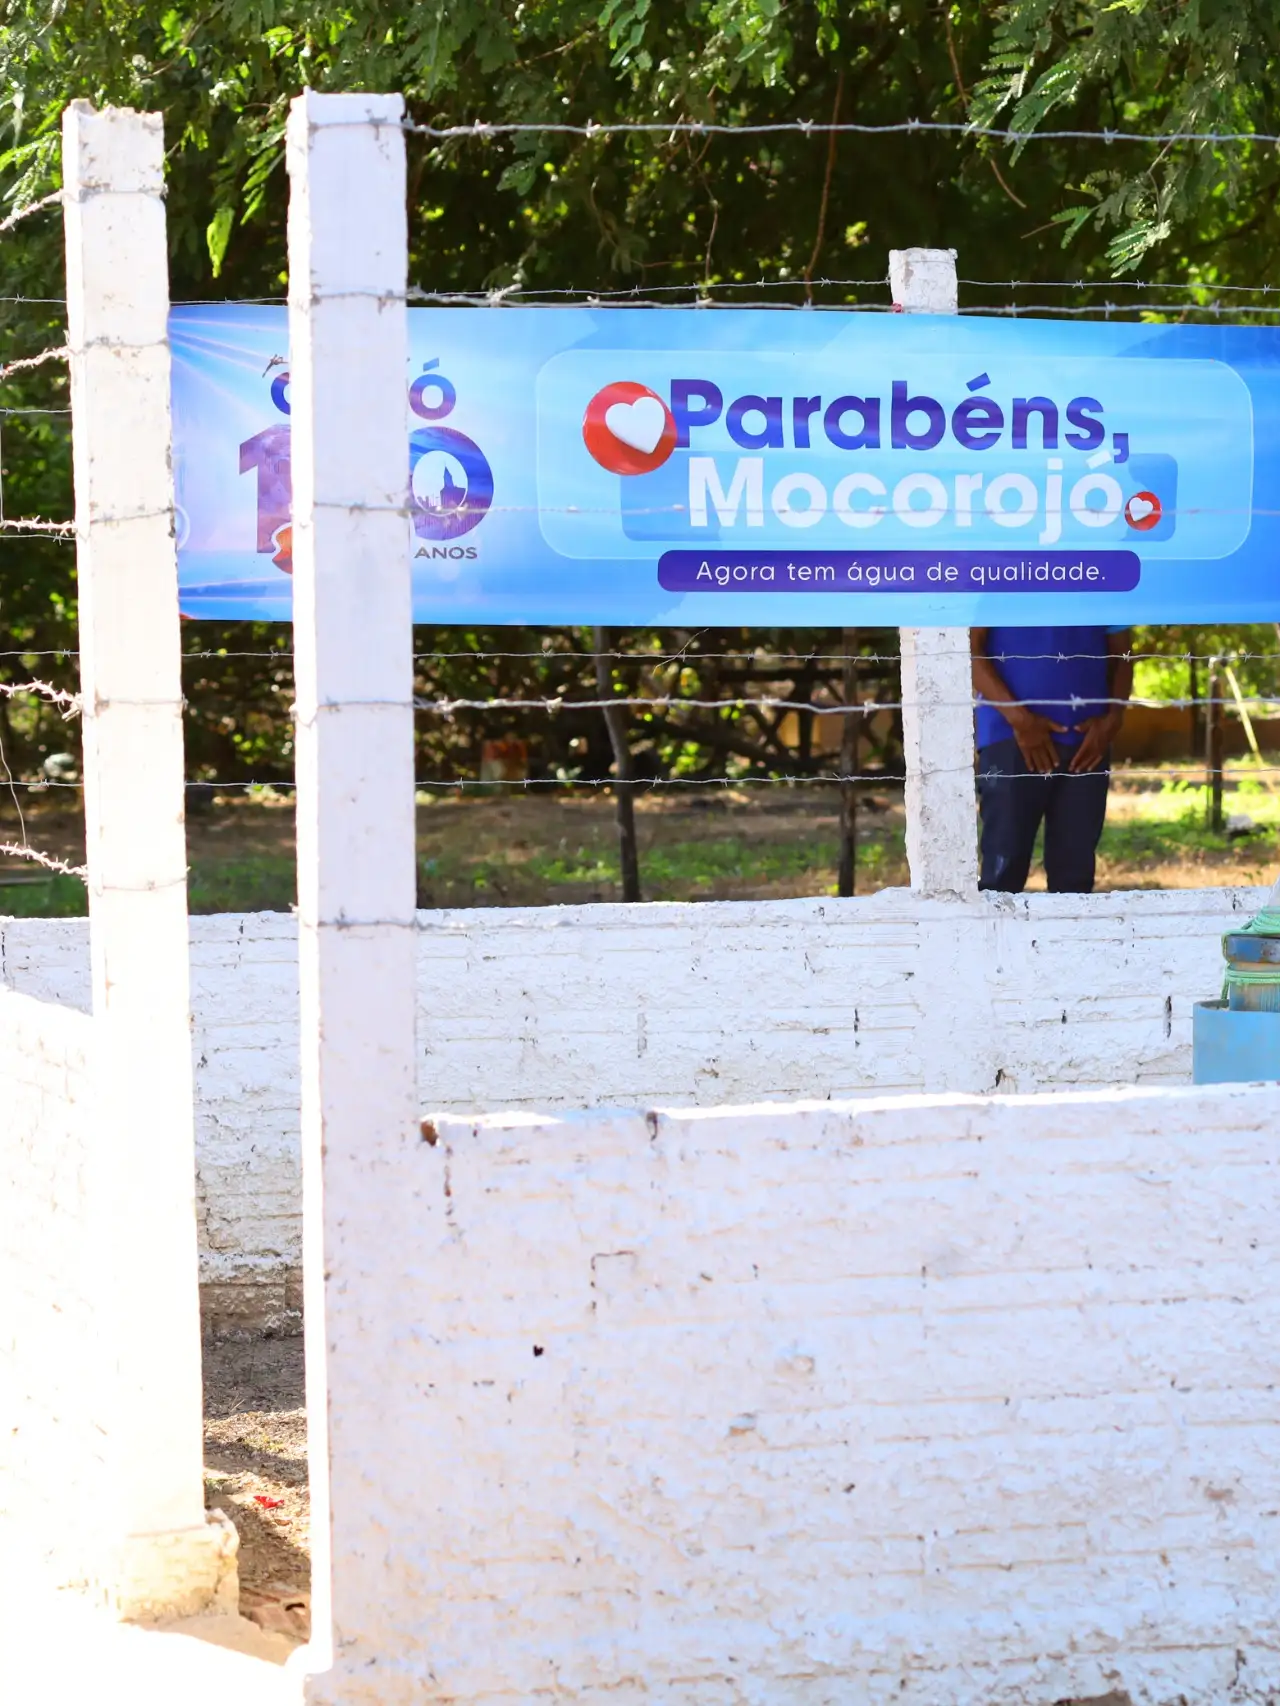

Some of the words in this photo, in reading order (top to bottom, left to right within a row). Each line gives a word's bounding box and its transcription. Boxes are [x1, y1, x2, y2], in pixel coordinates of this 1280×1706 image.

[669, 372, 1130, 463] Parabéns,
[239, 424, 494, 553] 10
[414, 546, 478, 560] ANOS
[696, 561, 775, 586] Agora
[788, 562, 836, 581] tem
[848, 559, 916, 586] água
[927, 561, 959, 582] de
[970, 561, 1107, 587] qualidade.
